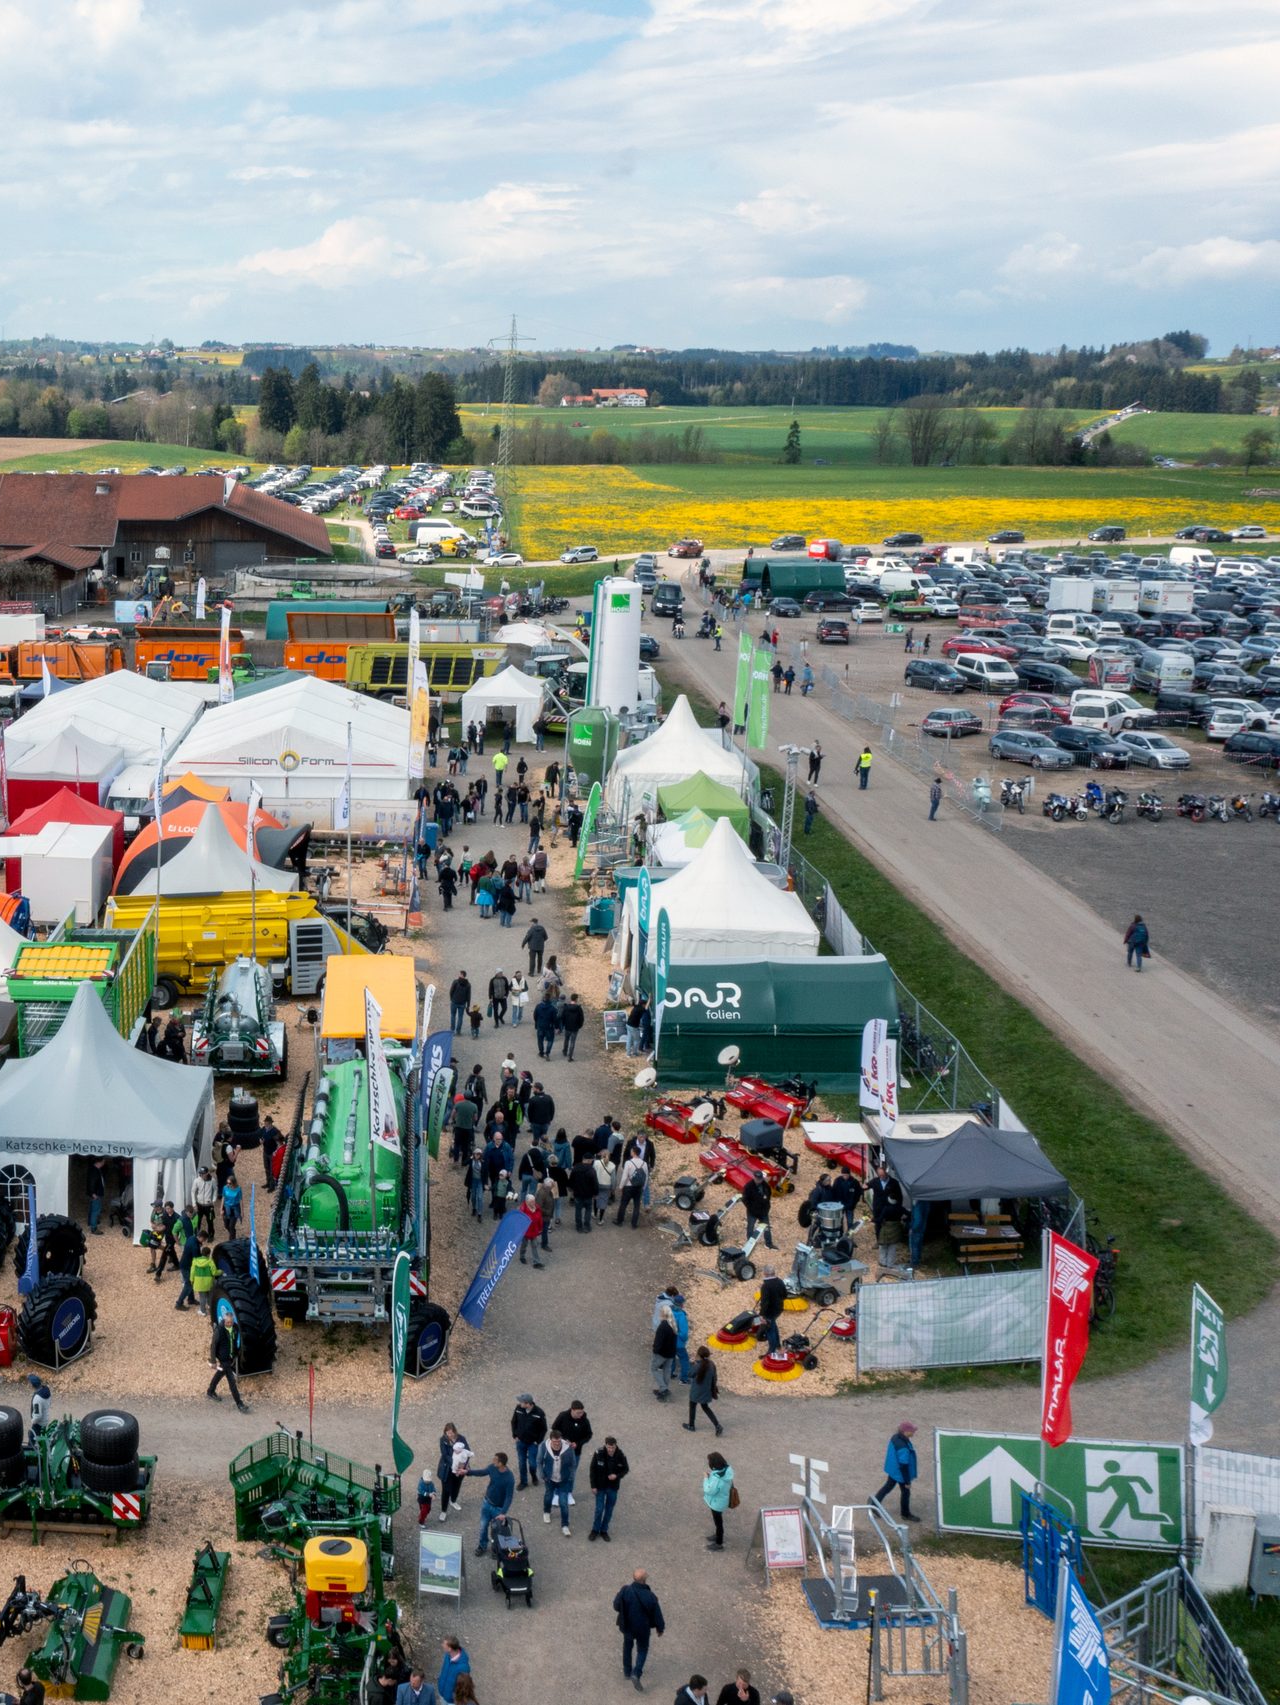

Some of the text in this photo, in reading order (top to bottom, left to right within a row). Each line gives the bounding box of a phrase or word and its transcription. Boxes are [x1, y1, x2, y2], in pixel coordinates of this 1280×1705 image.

[1143, 587, 1160, 601] Hertz
[573, 737, 592, 746] HORN
[238, 757, 335, 766] Silicon Form
[705, 1009, 741, 1020] folien
[5, 1140, 134, 1156] Katzschke-Menz Isny
[1195, 1297, 1223, 1332] EXIT
